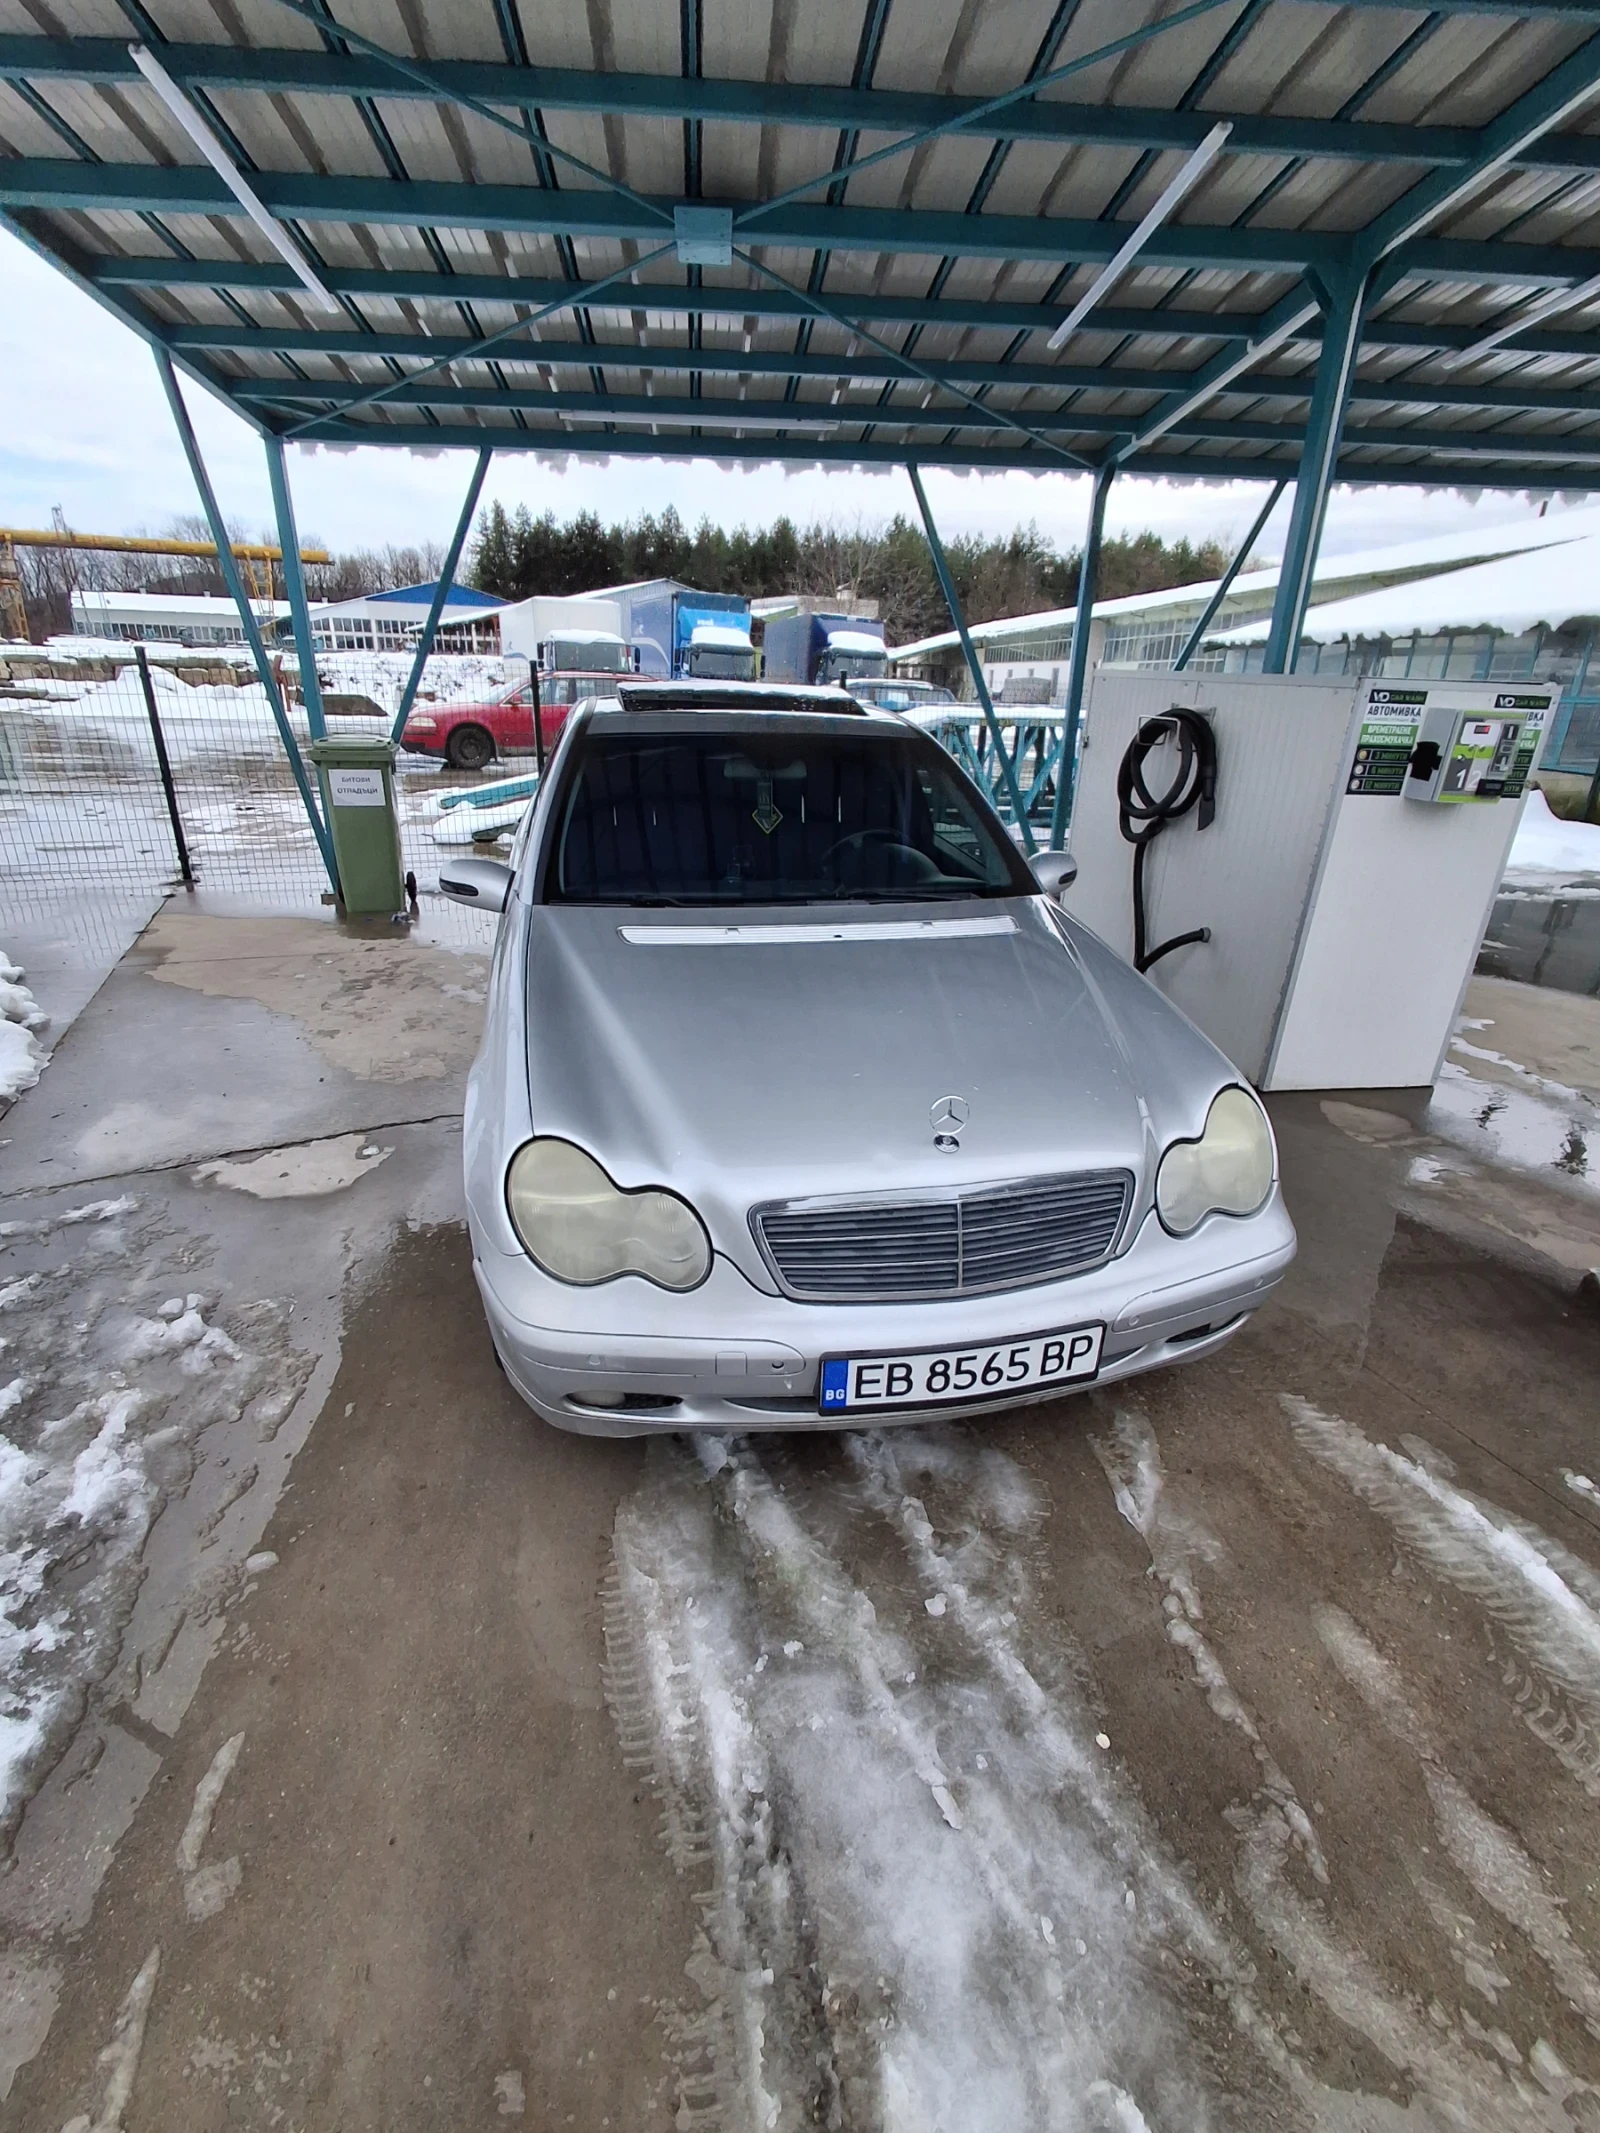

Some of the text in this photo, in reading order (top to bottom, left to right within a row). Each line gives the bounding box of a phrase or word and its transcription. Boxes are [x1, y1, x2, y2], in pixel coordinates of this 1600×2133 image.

[1367, 705, 1421, 717] АВТОМИВКА
[1456, 769, 1467, 788] 1
[1467, 770, 1482, 788] 2
[336, 787, 378, 795] ОТПАДЪЦИ
[855, 1334, 1094, 1399] EB 8565 BP
[825, 1388, 845, 1401] BG
